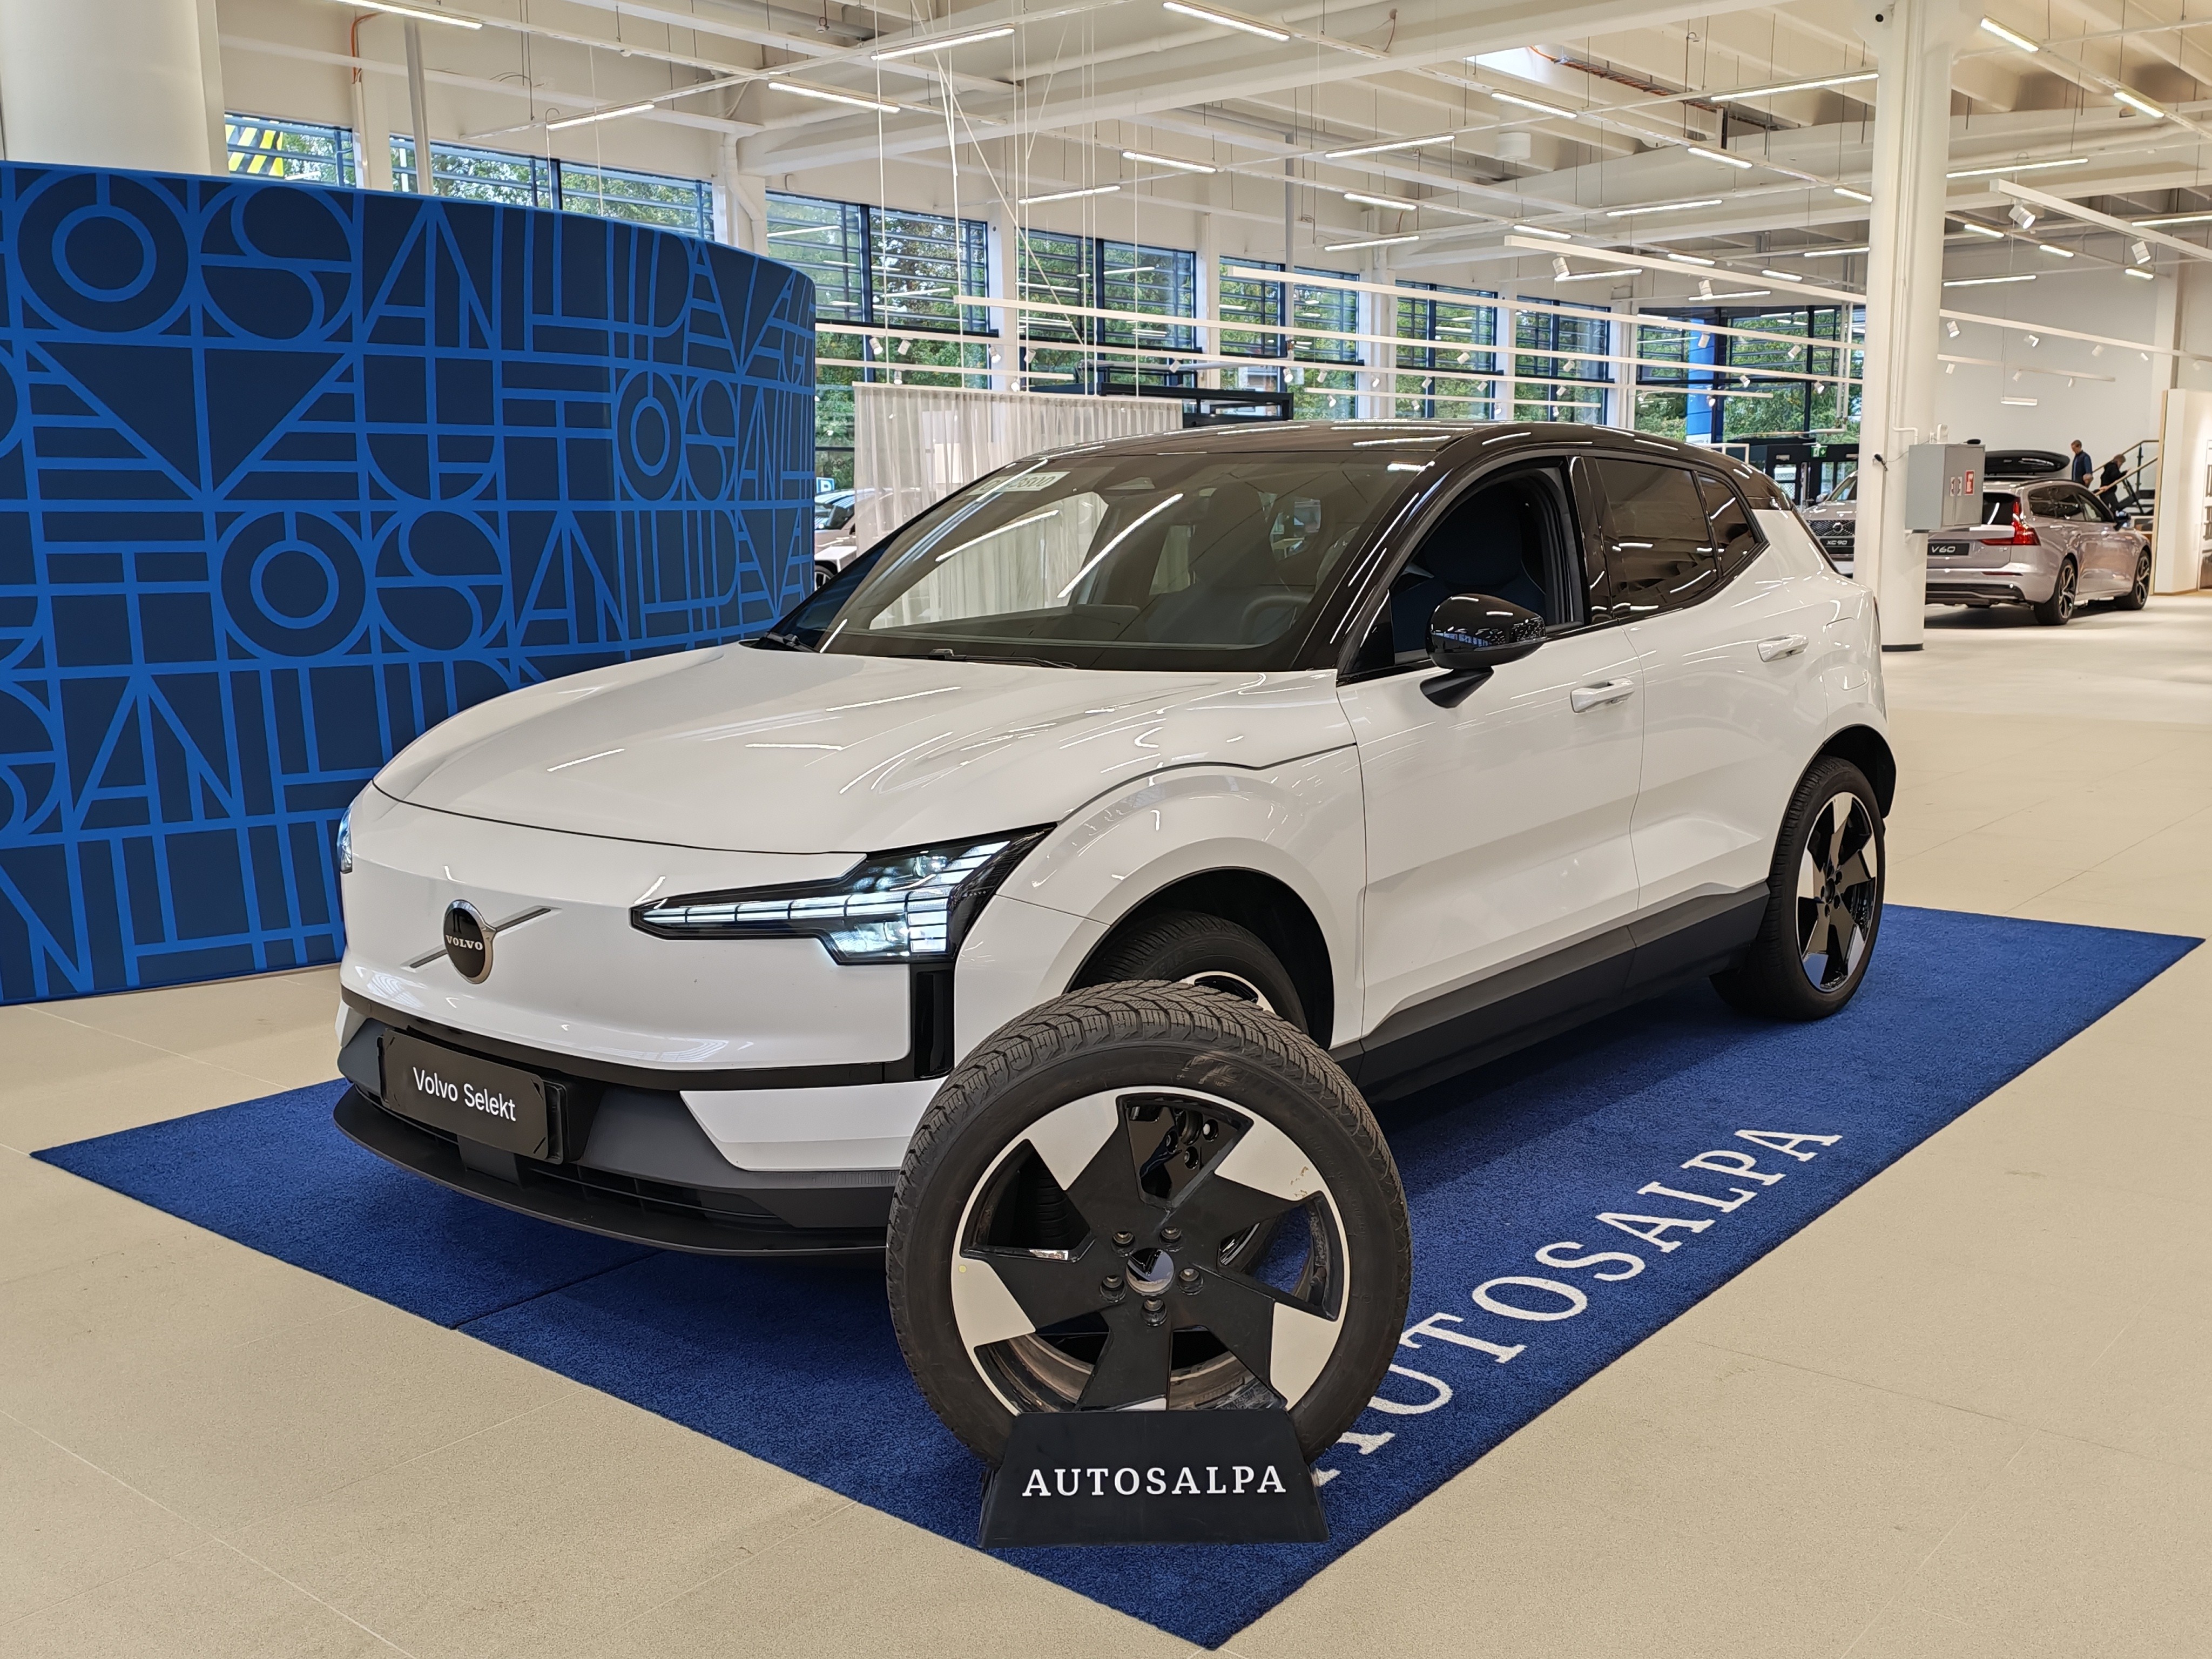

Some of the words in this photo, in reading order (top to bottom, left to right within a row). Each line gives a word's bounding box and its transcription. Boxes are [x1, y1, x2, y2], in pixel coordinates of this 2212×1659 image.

[446, 935, 483, 950] VOLVO
[413, 1066, 458, 1102] Volvo
[463, 1083, 516, 1122] Selekt
[1311, 1129, 1843, 1487] UTOSALPA
[1021, 1465, 1287, 1498] AUTOSALPA
